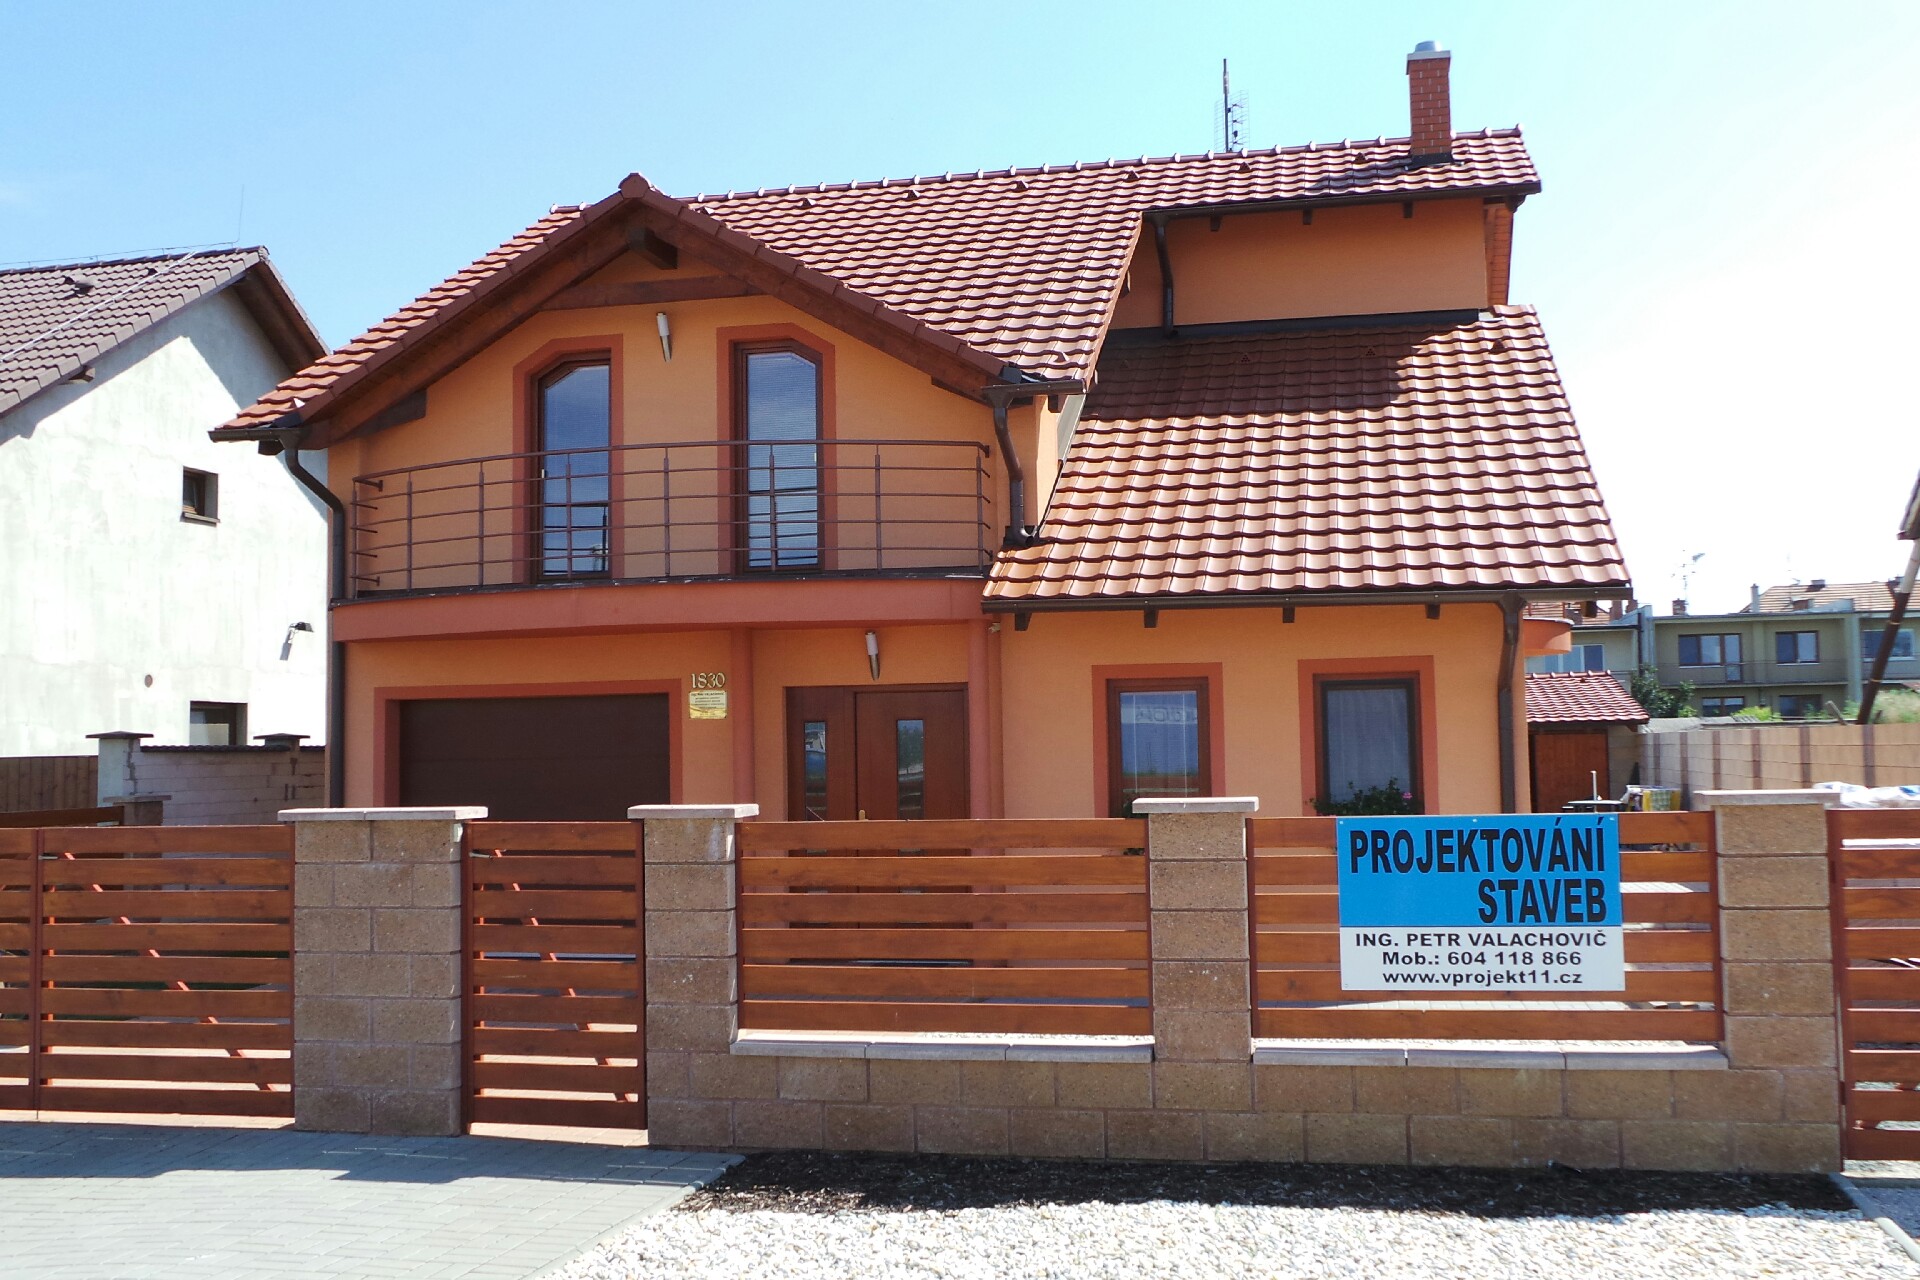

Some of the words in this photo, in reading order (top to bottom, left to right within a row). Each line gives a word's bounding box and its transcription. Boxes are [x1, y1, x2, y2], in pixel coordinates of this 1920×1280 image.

[691, 672, 726, 689] 1830
[1350, 816, 1605, 874] PROJEKTOVÁNÍ
[1478, 878, 1607, 924] STAVEB
[1355, 933, 1399, 947] ING.
[1407, 933, 1461, 947] PETR
[1468, 929, 1607, 947] VALACHOVIČ
[1382, 951, 1440, 966] Mob.:
[1447, 951, 1486, 965] 604
[1495, 951, 1534, 965] 118
[1542, 951, 1582, 965] 866
[1383, 970, 1583, 985] www.vprojekt11.cz
